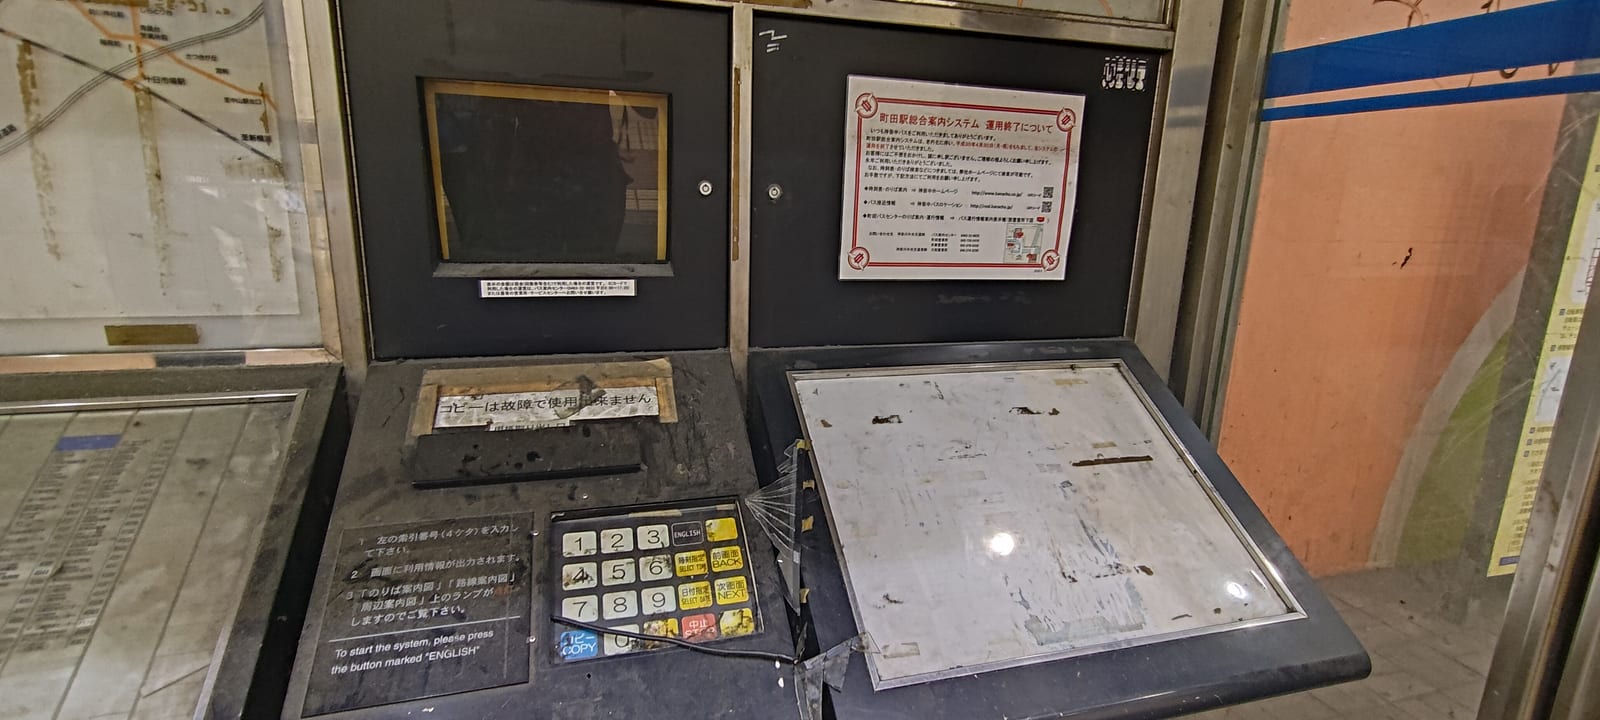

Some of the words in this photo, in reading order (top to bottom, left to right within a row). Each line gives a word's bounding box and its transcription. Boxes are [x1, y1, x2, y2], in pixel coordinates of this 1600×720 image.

[879, 112, 979, 128] 町田駅総合案内システム
[985, 119, 1054, 134] 運用終了について
[610, 534, 625, 548] 2
[647, 529, 661, 544] 3
[674, 530, 701, 539] ENGLISH
[574, 537, 582, 551] 1
[365, 546, 410, 558] て下さい。
[712, 549, 739, 560] 前画面
[351, 570, 358, 580] 2
[370, 553, 520, 578] 画面に利用情報が出力されます。
[649, 560, 663, 575] 6
[679, 564, 694, 573] SELECT
[713, 558, 742, 569] BACK
[573, 567, 588, 583] 4
[612, 564, 626, 579] 5
[682, 585, 709, 597] 日付指定
[716, 580, 745, 591] 次画面
[346, 591, 353, 600] 3
[651, 592, 665, 607] 9
[681, 597, 697, 605] SELECT
[717, 589, 745, 600] NEXT
[572, 601, 588, 617] 7
[613, 597, 628, 612] 8
[350, 605, 466, 627] しますのでご覧下さい。
[689, 619, 707, 629] 中止
[336, 649, 347, 659] To
[350, 646, 373, 657] start
[375, 643, 392, 654] the
[393, 640, 432, 653] system,
[433, 634, 466, 648] please
[467, 630, 494, 643] press
[614, 633, 630, 648] 0
[562, 643, 596, 656] COPY
[331, 664, 348, 675] the
[350, 660, 382, 673] button
[384, 655, 423, 668] marked
[425, 645, 480, 661] "ENGLISH"
